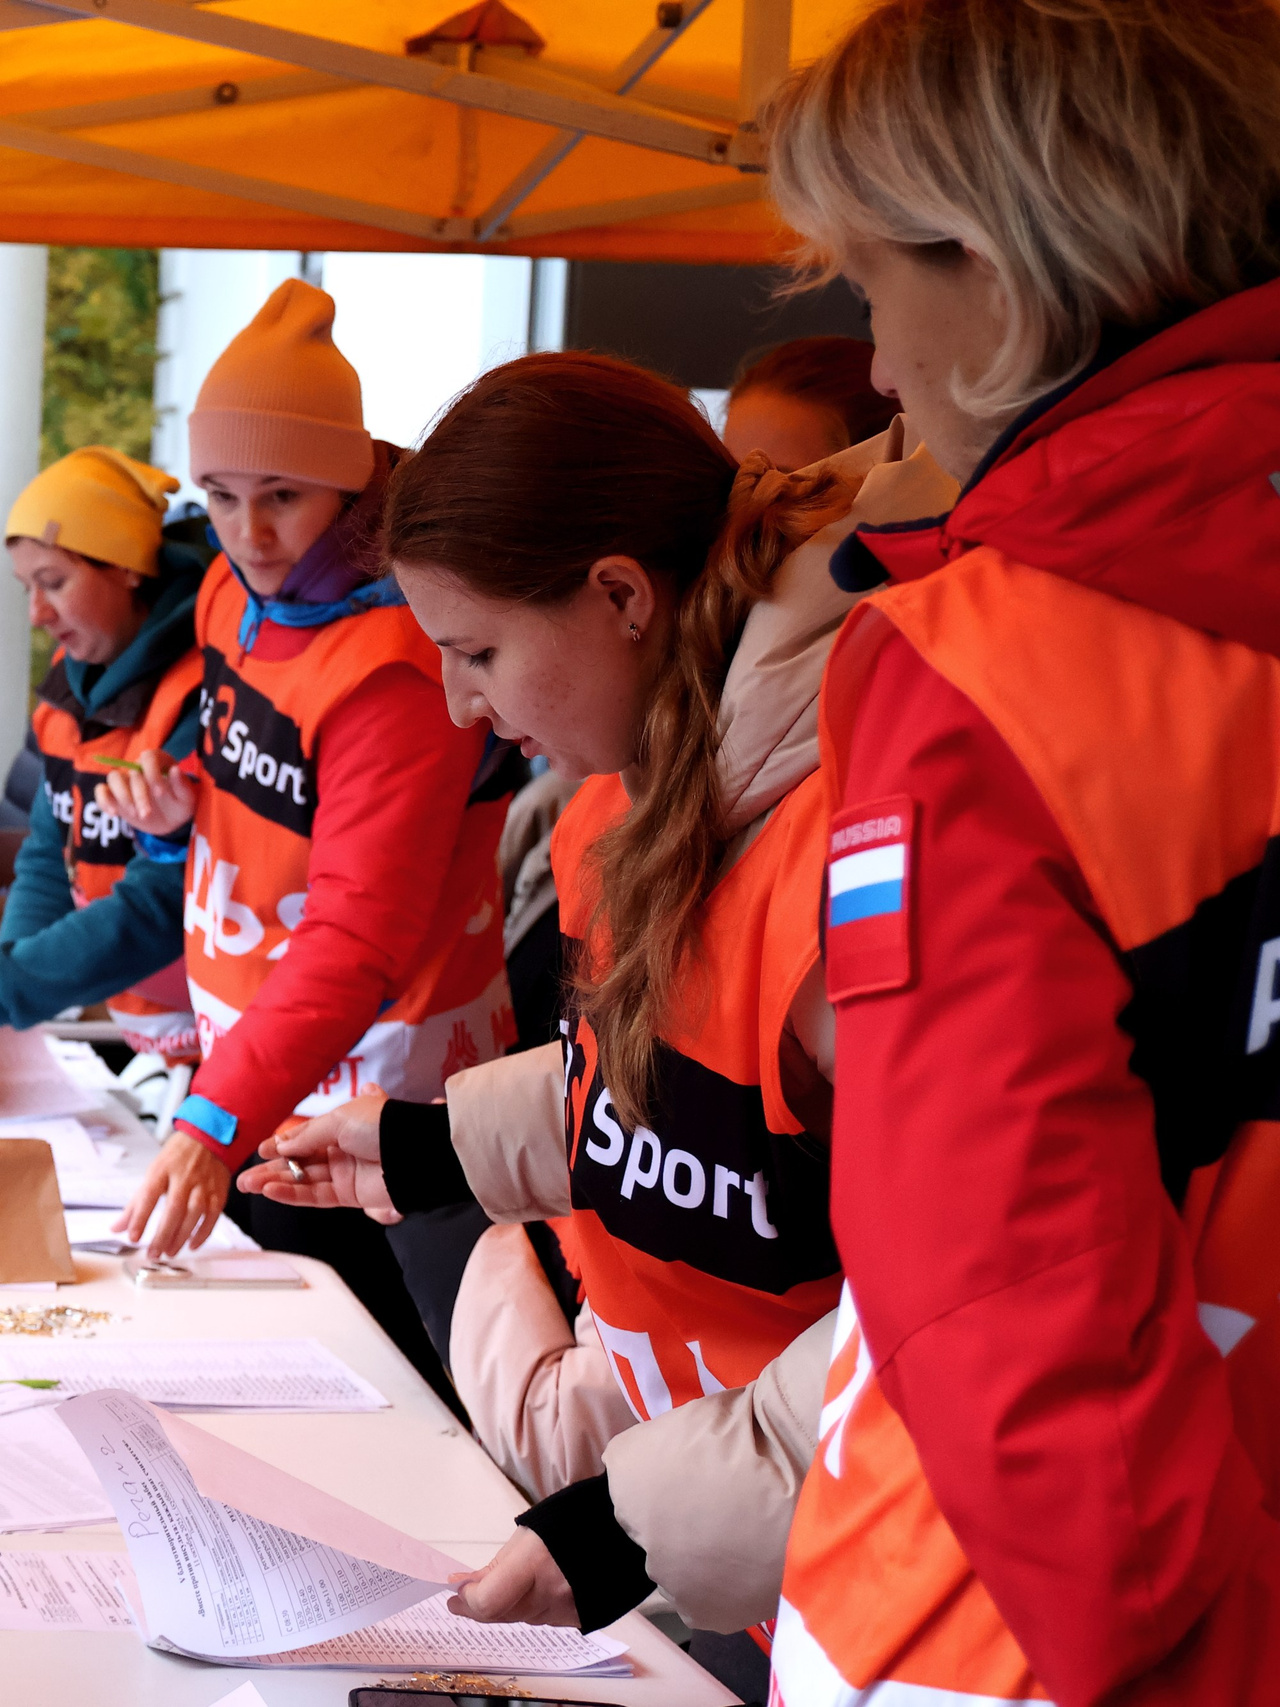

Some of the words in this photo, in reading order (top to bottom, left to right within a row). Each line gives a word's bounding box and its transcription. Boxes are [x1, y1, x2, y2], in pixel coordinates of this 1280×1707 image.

[220, 719, 308, 806] Sport
[829, 814, 902, 854] RUSSIA
[585, 1087, 780, 1240] Sport
[99, 1433, 115, 1455] 2
[317, 1578, 336, 1616] 10:50-11:00
[350, 1561, 373, 1600] 11:10-11:20
[352, 1584, 365, 1604] 11:10
[367, 1576, 381, 1596] 11:20
[295, 1609, 306, 1628] 10:30
[297, 1587, 315, 1625] 10:30-10:40
[305, 1583, 324, 1622] 10:40-10:50
[336, 1592, 349, 1611] 11:00
